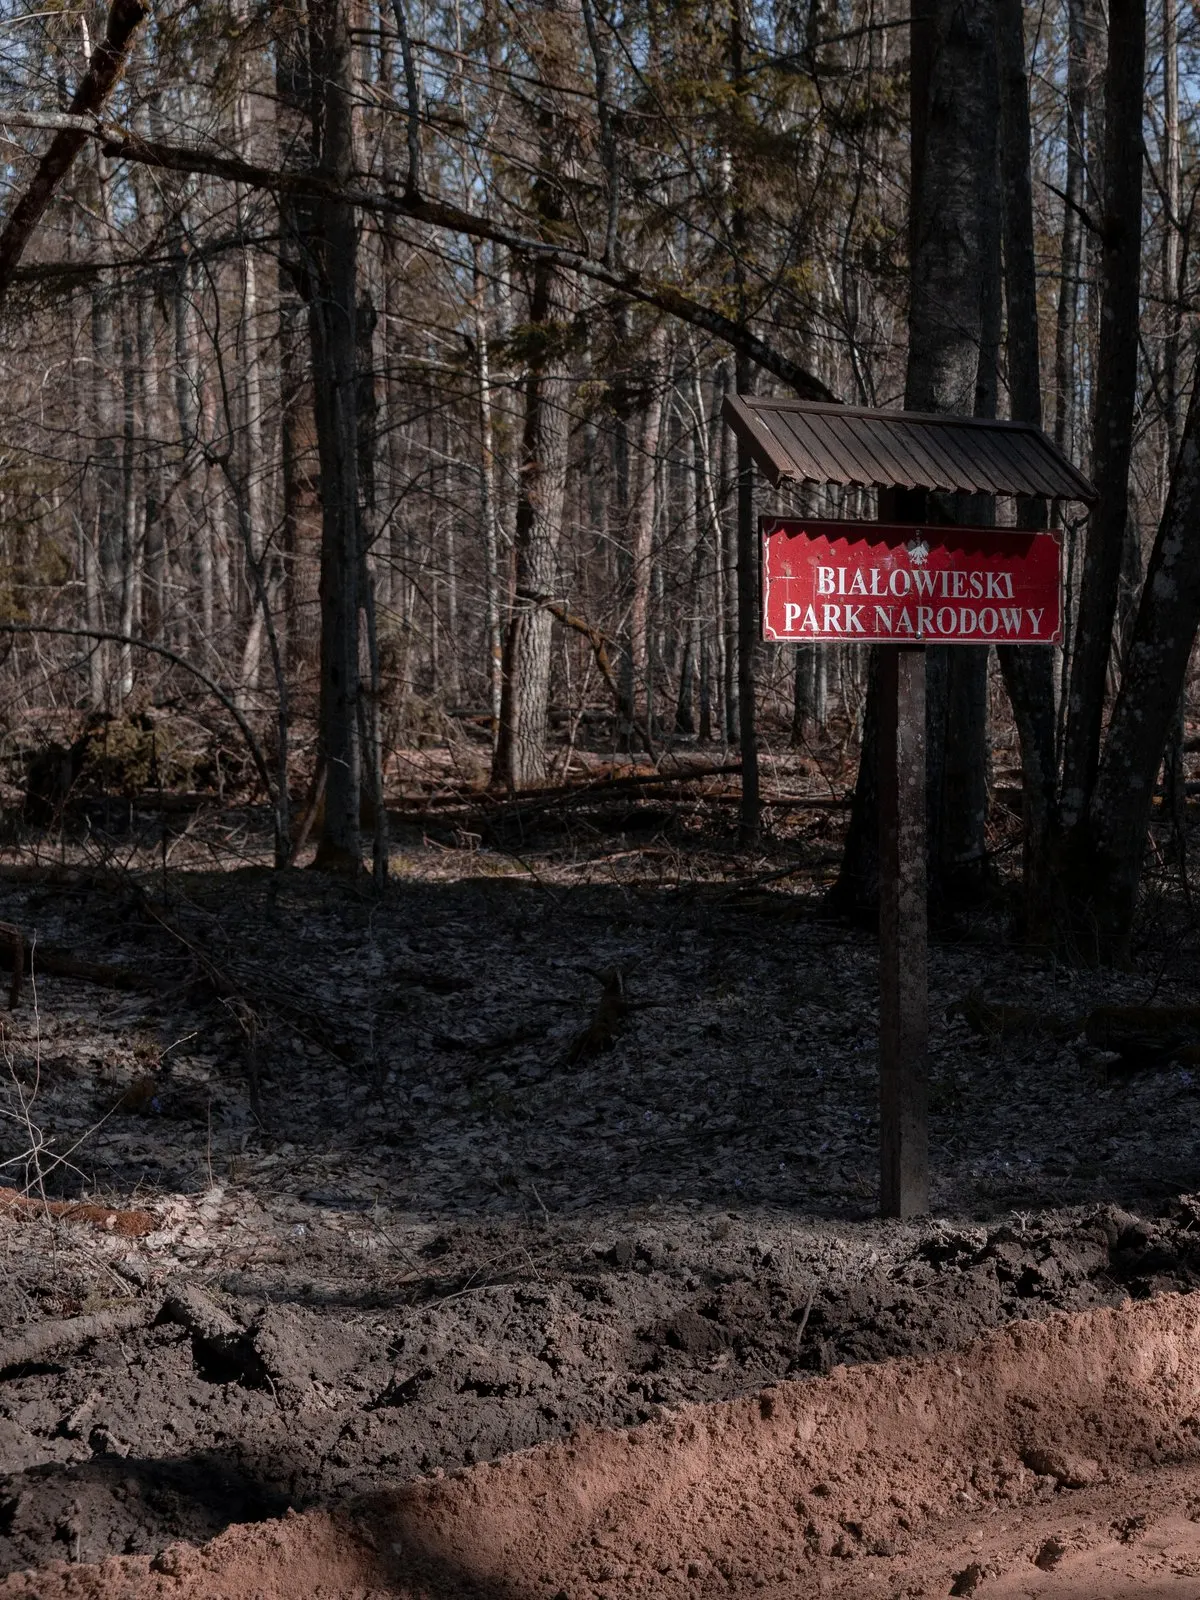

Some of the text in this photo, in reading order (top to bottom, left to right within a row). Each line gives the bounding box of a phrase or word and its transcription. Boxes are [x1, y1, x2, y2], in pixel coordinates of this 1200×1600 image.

[816, 566, 1015, 599] BIAŁOWIESKI
[782, 603, 1045, 635] PARK NARODOWY
